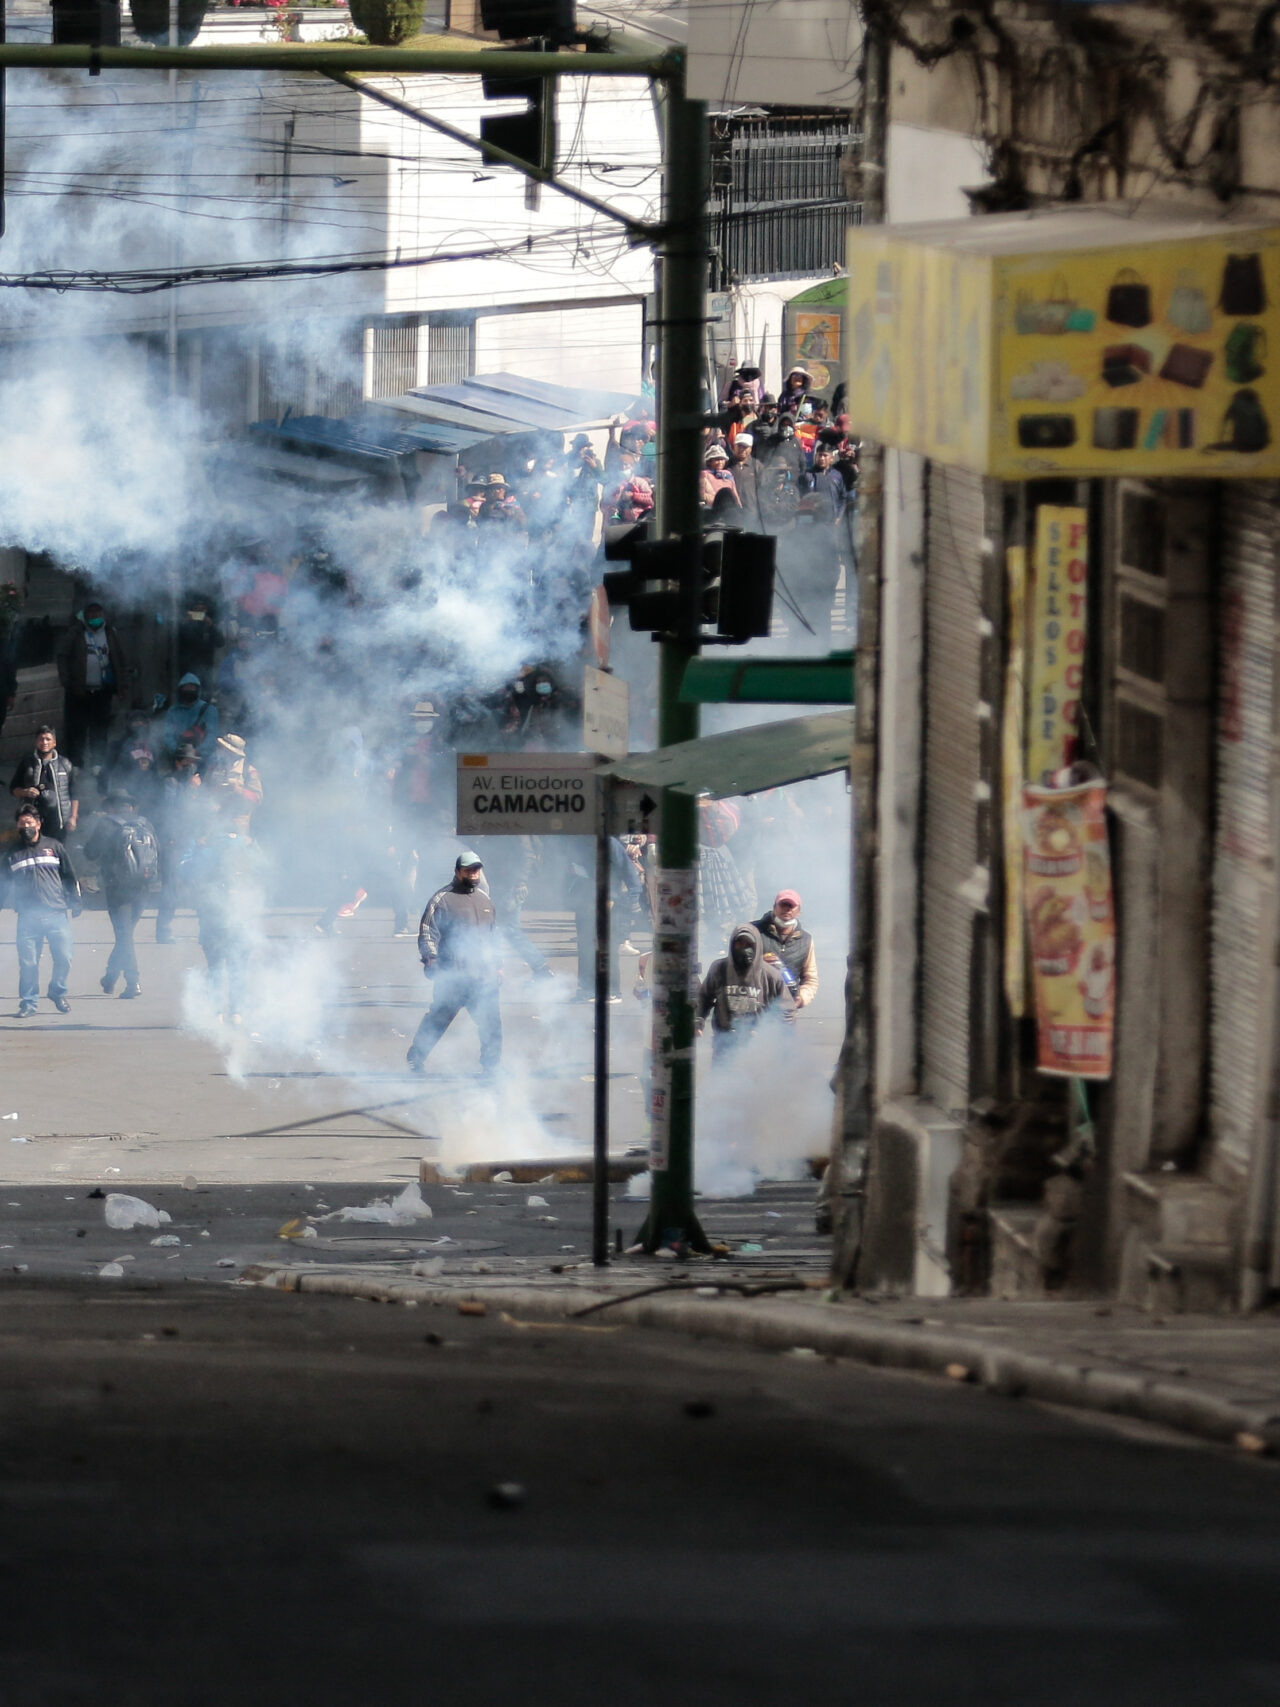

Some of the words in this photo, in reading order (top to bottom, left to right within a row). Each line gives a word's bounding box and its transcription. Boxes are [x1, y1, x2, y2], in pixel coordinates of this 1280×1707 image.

[472, 775, 496, 790] AV.
[500, 775, 585, 790] Eliodoro
[473, 793, 586, 814] CAMACHO
